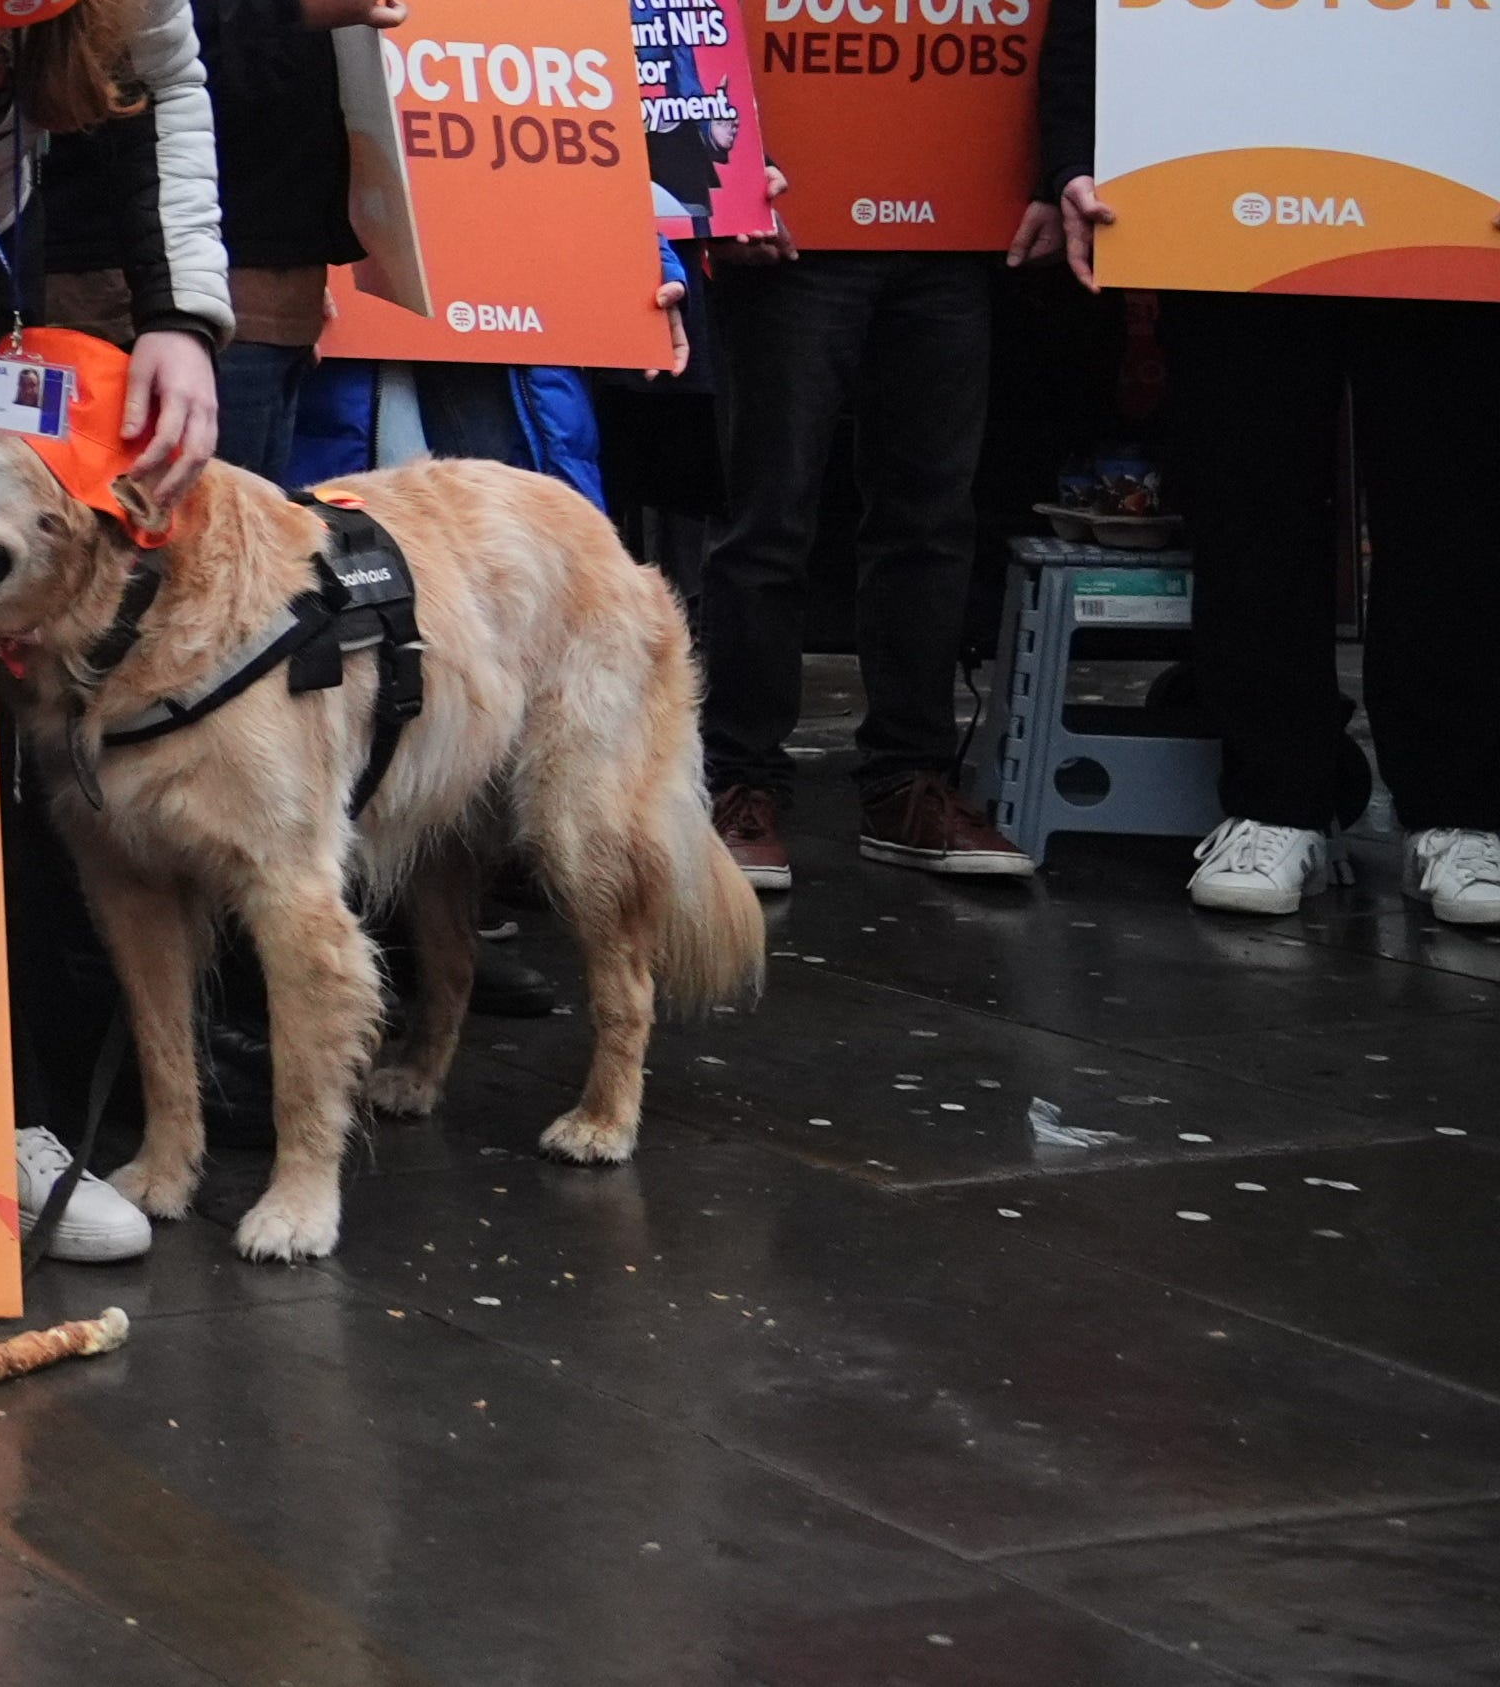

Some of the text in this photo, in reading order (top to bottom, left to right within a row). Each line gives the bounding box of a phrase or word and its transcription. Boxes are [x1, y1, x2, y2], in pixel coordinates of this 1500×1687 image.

[669, 10, 728, 46] NHS
[762, 32, 1028, 83] NEED JOBS
[490, 113, 620, 169] JOBS
[879, 202, 935, 224] BMA
[1276, 197, 1365, 227] BMA
[478, 304, 542, 333] BMA
